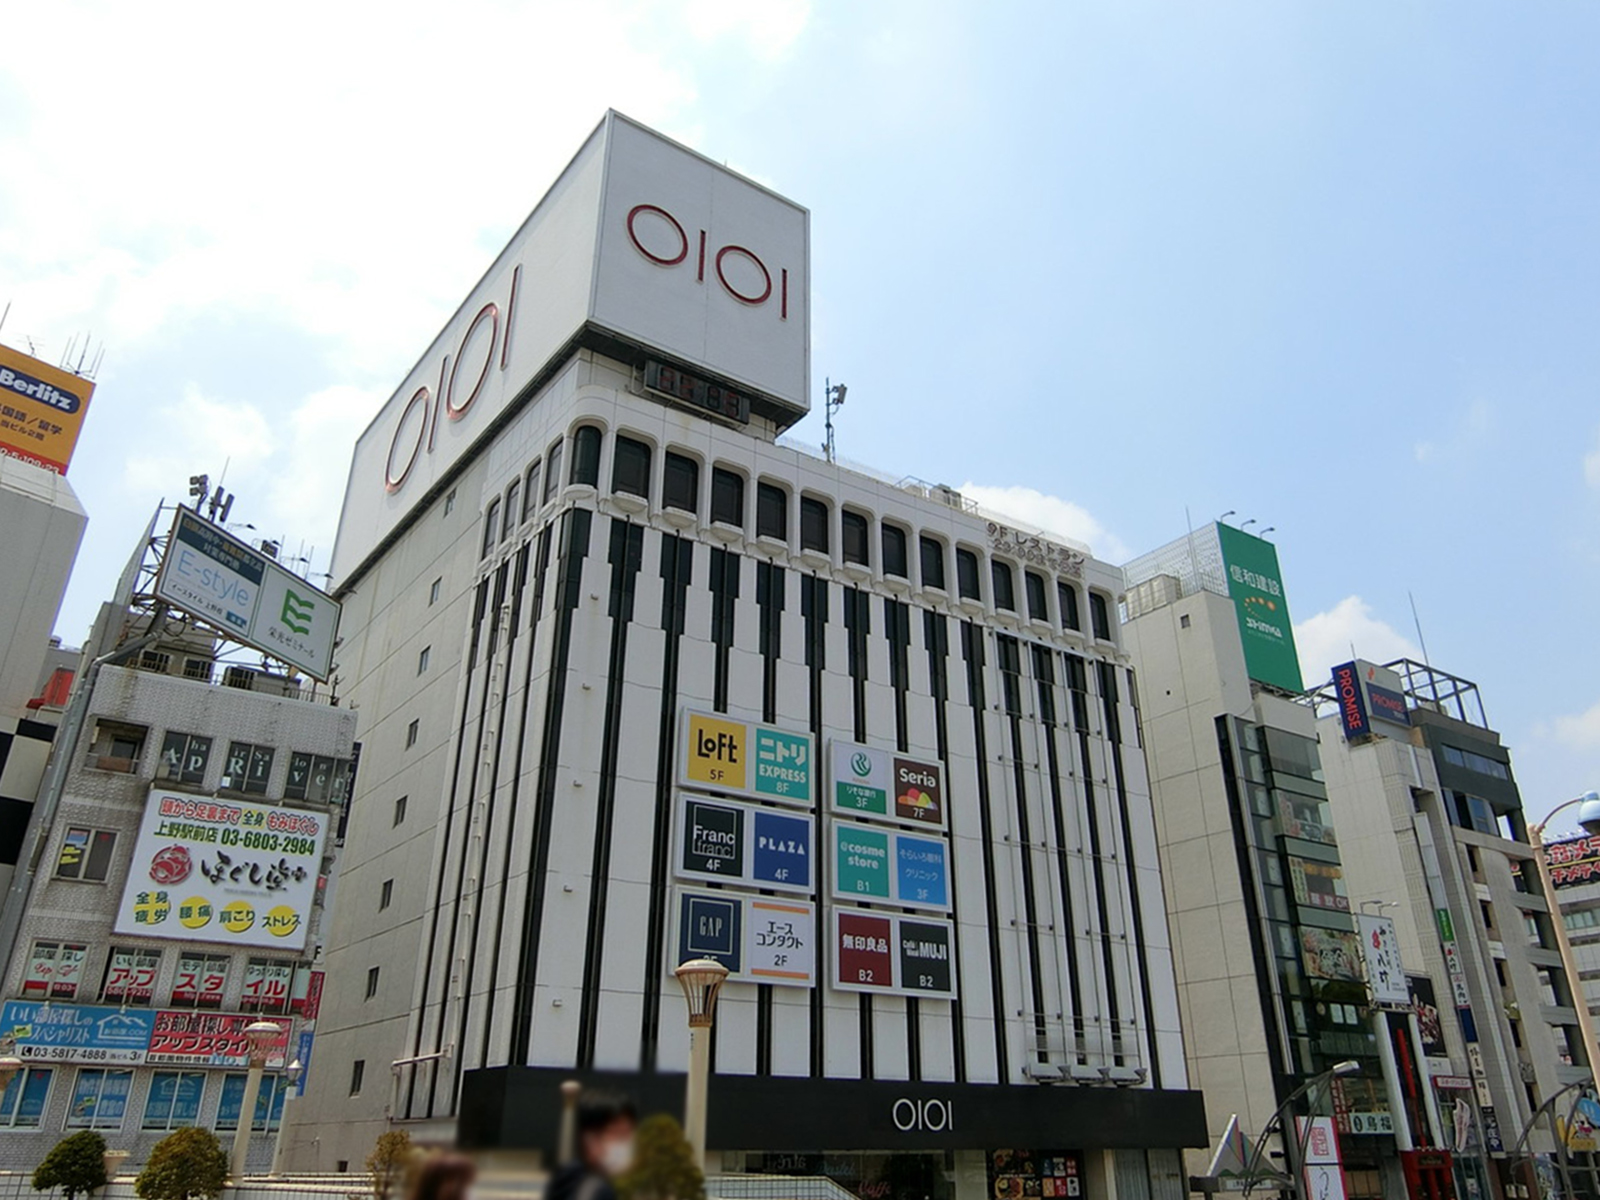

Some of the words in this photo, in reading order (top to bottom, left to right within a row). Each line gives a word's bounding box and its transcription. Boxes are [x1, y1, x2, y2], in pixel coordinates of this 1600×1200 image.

[0, 369, 72, 409] Berlitz
[987, 522, 1008, 538] 9F
[1015, 532, 1085, 565] レストラン
[177, 550, 250, 607] E-style
[1338, 667, 1362, 730] PROMISE
[1371, 693, 1404, 713] PROMISE
[759, 737, 806, 766] ニトリ
[710, 769, 724, 780] 5F
[759, 764, 806, 783] EXPRESS
[899, 768, 937, 787] Seria
[776, 781, 789, 793] 8F
[856, 797, 868, 808] 3F
[158, 797, 241, 826] 頭から足裏まで
[242, 810, 265, 827] 全身
[266, 811, 319, 837] もみほぐし
[912, 807, 925, 818] 7F
[154, 820, 219, 844] 上野駅前店
[220, 827, 316, 855] 03-6803-2984
[693, 825, 735, 845] Franc
[696, 841, 732, 857] franc
[759, 836, 805, 855] PLAZA
[840, 841, 885, 857] @cosme
[706, 859, 721, 871] 4F
[848, 855, 879, 869] store
[774, 869, 789, 881] 4F
[905, 867, 938, 881] クリニック
[856, 880, 870, 891] B1
[136, 891, 168, 905] 全身
[917, 889, 928, 900] 3F
[179, 904, 211, 919] 腰痛
[219, 909, 256, 924] 肩こり
[262, 913, 302, 929] ストレス
[699, 916, 722, 938] GAP
[767, 921, 793, 935] エース
[756, 933, 803, 949] コンタクト
[842, 933, 888, 953] 無印良品
[919, 942, 947, 960] MUJI
[774, 955, 787, 966] 2F
[110, 968, 157, 987] アップ
[858, 969, 873, 982] B2
[919, 975, 933, 987] B2
[10, 1006, 93, 1026] いい部屋探しの
[30, 1025, 90, 1045] スペシャリスト
[33, 1047, 107, 1060] 03-5817-4888
